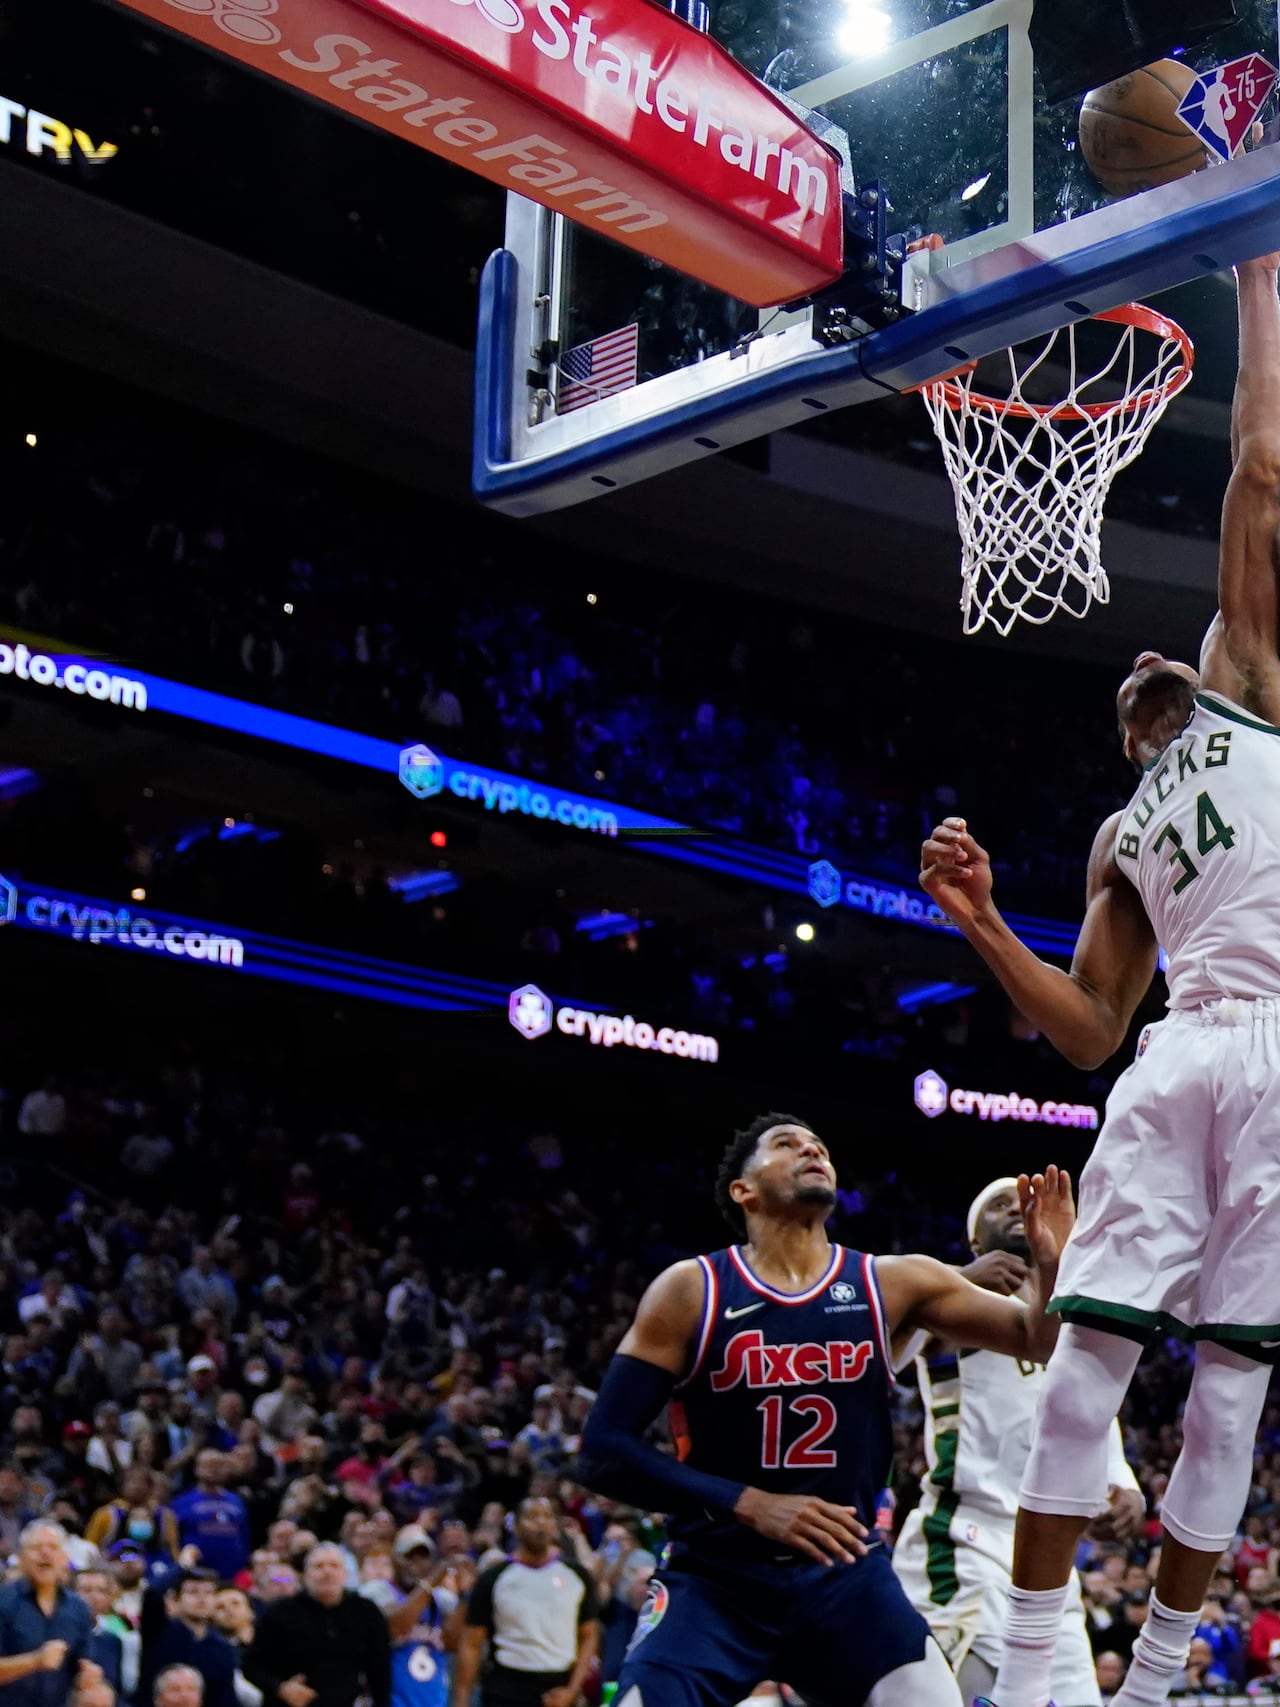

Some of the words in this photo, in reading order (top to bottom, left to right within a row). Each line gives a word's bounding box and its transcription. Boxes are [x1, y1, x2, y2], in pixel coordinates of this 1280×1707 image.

[1235, 69, 1255, 102] 75
[449, 770, 618, 838] crypto.com
[1119, 731, 1232, 860] BUCKS
[1153, 791, 1235, 896] 34
[26, 896, 244, 967] crypto.com
[556, 1007, 719, 1063] crypto.com
[950, 1088, 1098, 1130] crypto.com
[709, 1329, 874, 1393] Sixers
[756, 1394, 837, 1469] 12
[407, 1645, 438, 1682] 6
